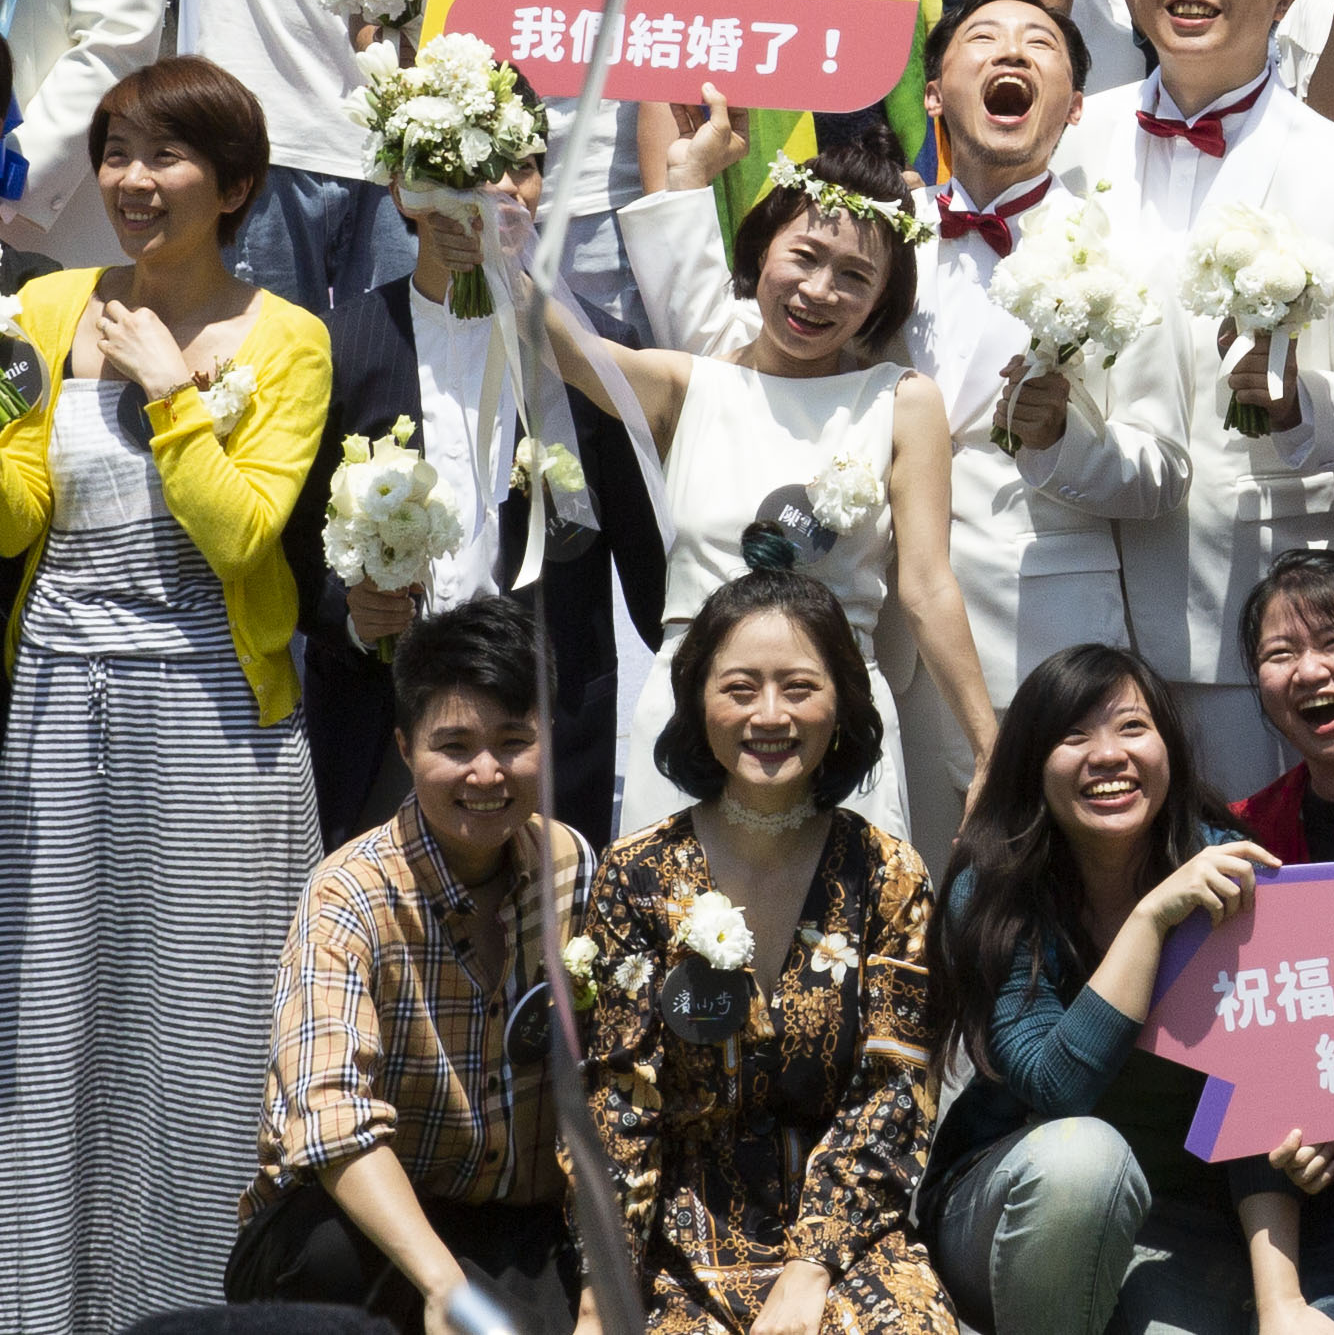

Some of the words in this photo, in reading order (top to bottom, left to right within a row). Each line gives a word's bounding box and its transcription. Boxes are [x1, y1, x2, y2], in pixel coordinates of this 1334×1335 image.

[509, 6, 842, 75] 我們結婚了！
[4, 360, 30, 381] nie
